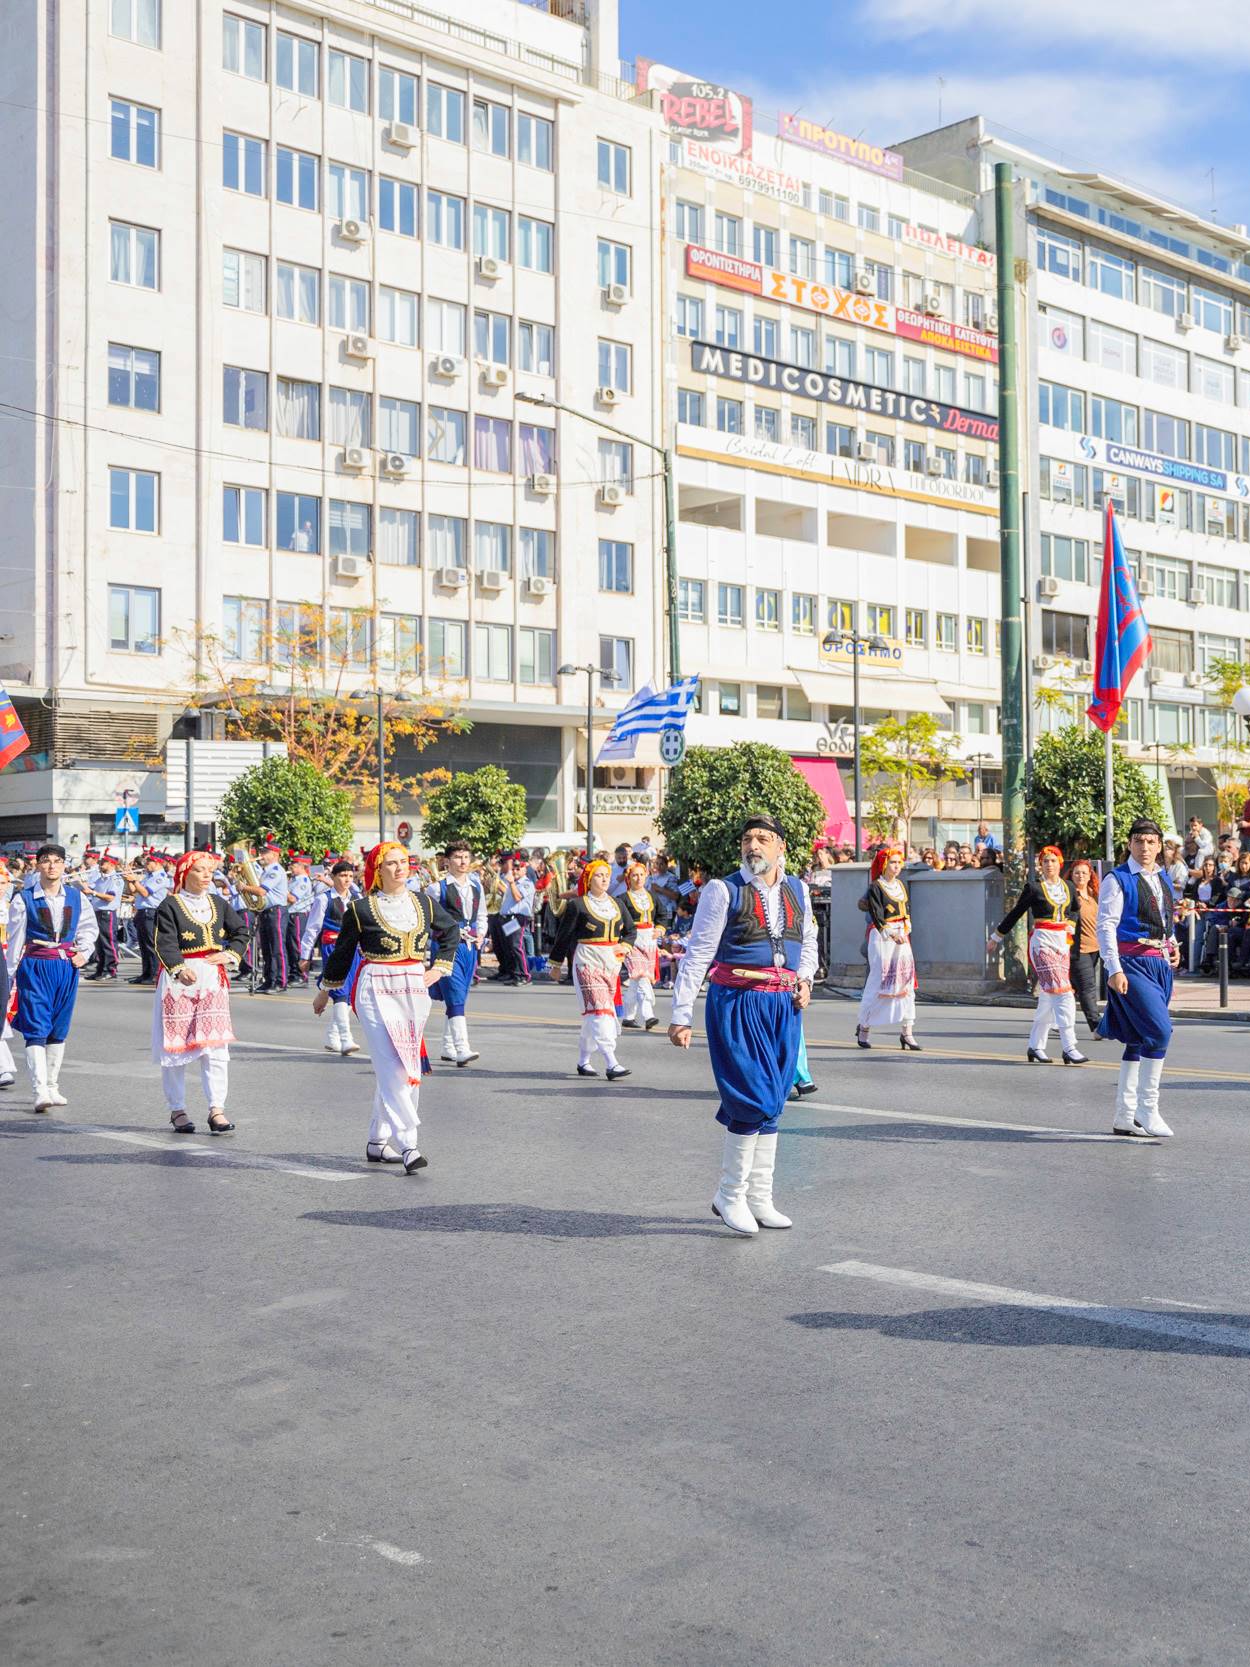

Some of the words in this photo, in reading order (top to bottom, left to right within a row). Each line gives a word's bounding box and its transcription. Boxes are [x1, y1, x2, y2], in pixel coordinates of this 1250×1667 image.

[691, 84, 725, 99] 105.2
[661, 93, 737, 132] REBEL
[800, 121, 884, 166] ΠΡΟΤΥΠΟ
[688, 141, 800, 192] ΕΝΟΙΚΙΑΖΕΤΑΙ
[690, 249, 761, 281] ΦΡΟΝΤΙΣΤΗΡΙΑ
[771, 272, 889, 328] ΣΤΟΧΟΣ
[897, 310, 951, 336] ΘΕΩΡΗΤΙΚΗ
[944, 408, 998, 440] Derma
[1210, 472, 1223, 487] SA
